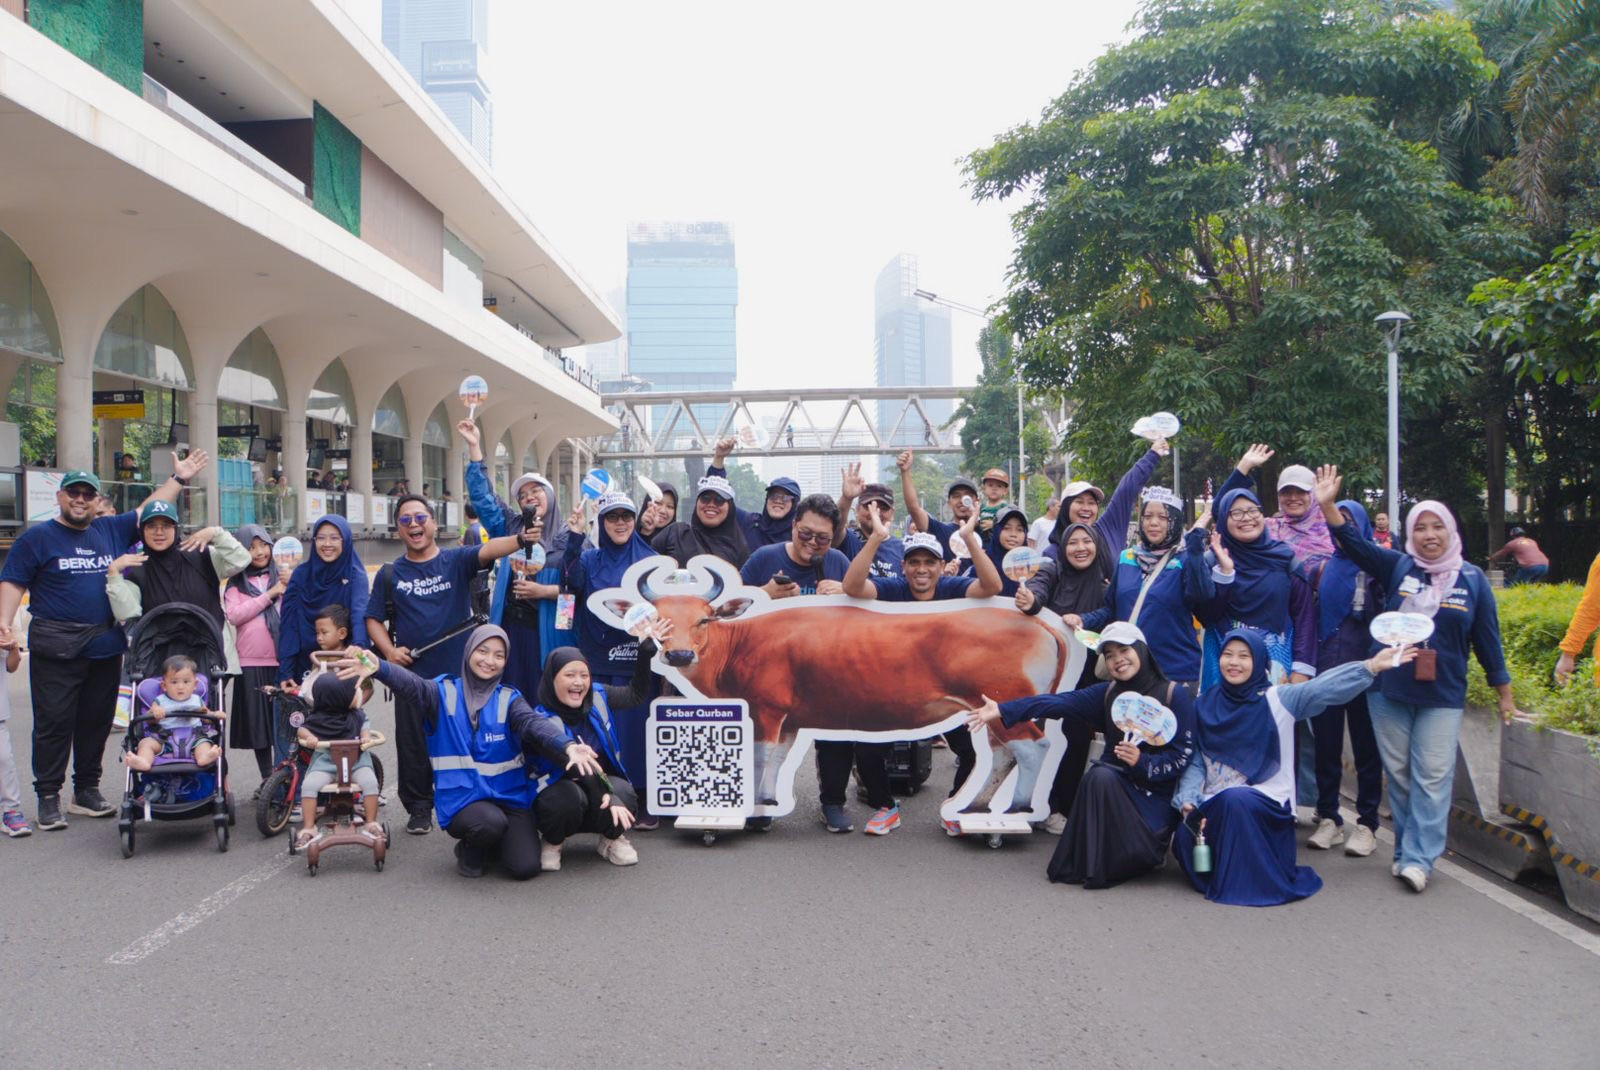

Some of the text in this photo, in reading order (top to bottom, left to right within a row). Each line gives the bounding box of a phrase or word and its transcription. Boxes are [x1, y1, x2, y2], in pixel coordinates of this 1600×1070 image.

[59, 555, 113, 570] BERKAH
[413, 576, 442, 587] Sebar
[413, 582, 451, 596] Qurban
[665, 708, 733, 717] Sebar Qurban
